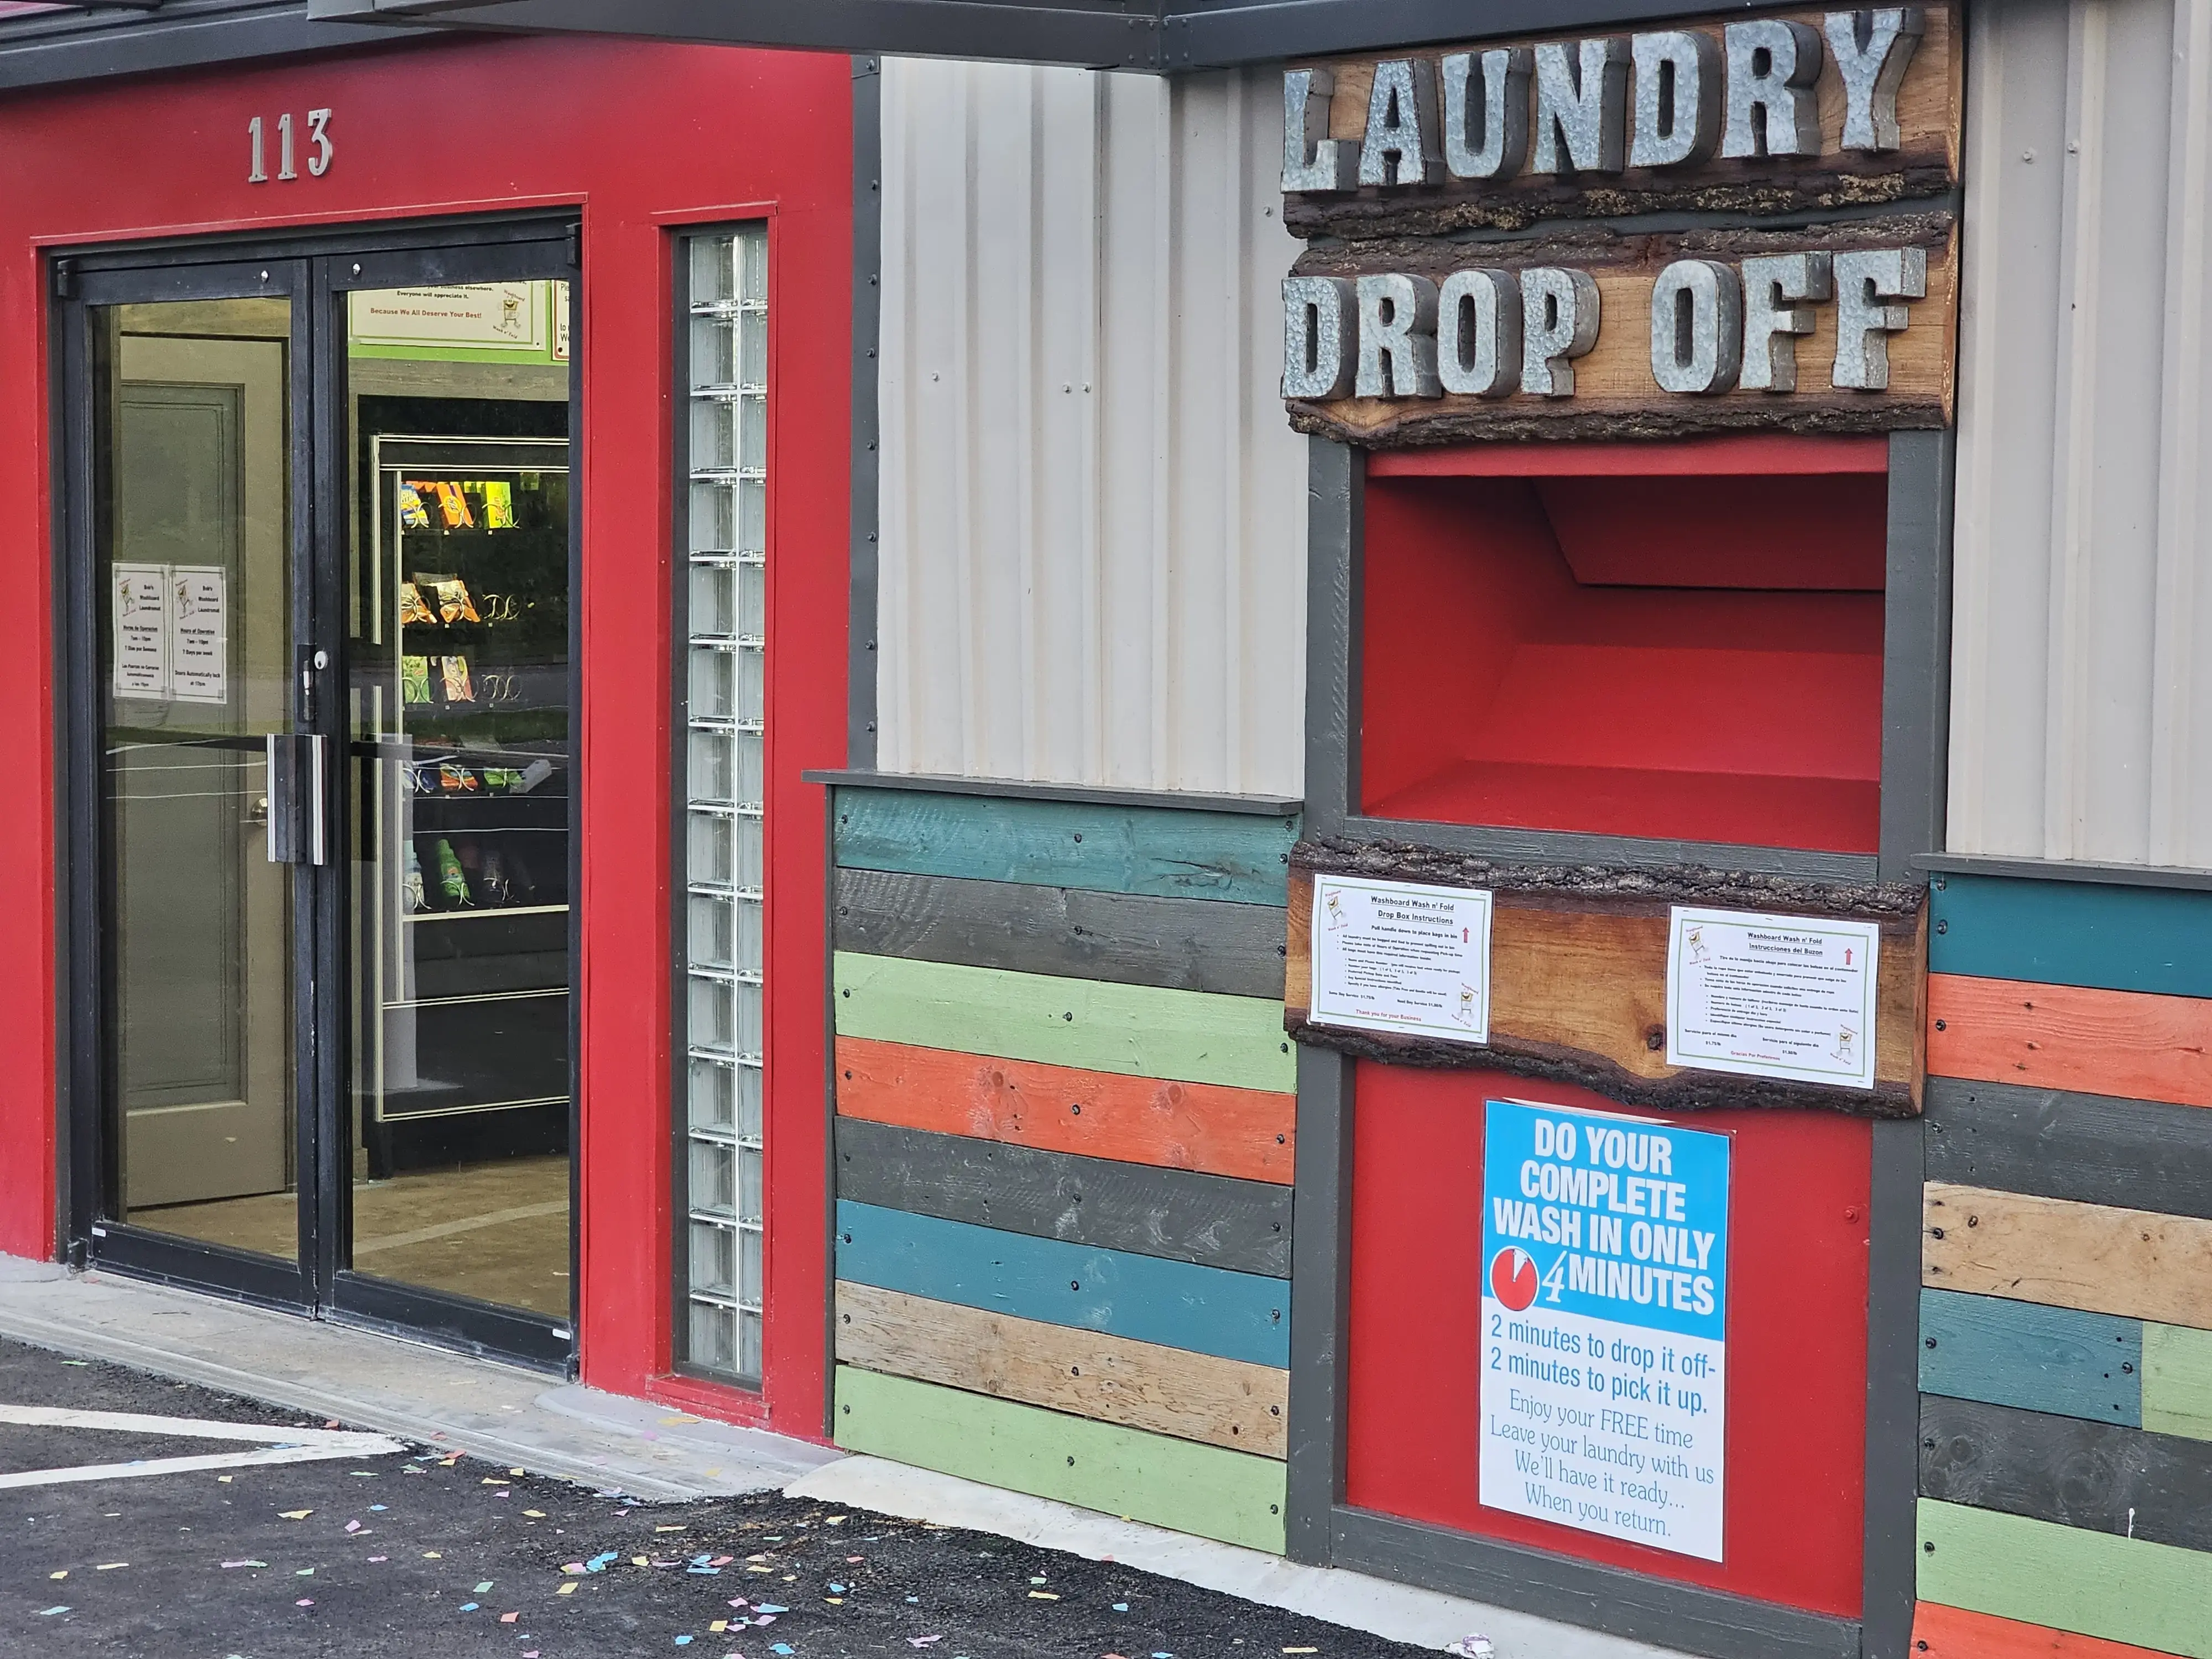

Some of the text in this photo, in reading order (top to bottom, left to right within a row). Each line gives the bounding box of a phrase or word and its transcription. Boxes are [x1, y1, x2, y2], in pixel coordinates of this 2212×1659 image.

[1280, 7, 1924, 192] LAUNDRY
[249, 108, 332, 182] 113
[1280, 247, 1926, 400] DROP OFF
[1371, 896, 1410, 906] Washboard
[1412, 900, 1430, 909] Wash
[1378, 910, 1394, 919] Drop
[1412, 914, 1453, 925] Instructions
[1747, 932, 1781, 941] Washboard
[1749, 943, 1791, 952] Instrucciones
[1535, 1119, 1672, 1175] DO YOUR
[1521, 1160, 1686, 1222] COMPLETE
[1493, 1197, 1715, 1270] WASH IN ONLY
[1542, 1250, 1714, 1315] 4 MINUTES
[1491, 1314, 1715, 1379] 2 minutes to drop it off-
[1491, 1347, 1707, 1416] 2 minutes to pick it up.
[1490, 1415, 1714, 1484] Leave your laundry with us
[1510, 1389, 1693, 1448] Enjoy your FREE time
[1515, 1449, 1684, 1509] We'll have it ready...
[1525, 1481, 1671, 1536] When you return.
